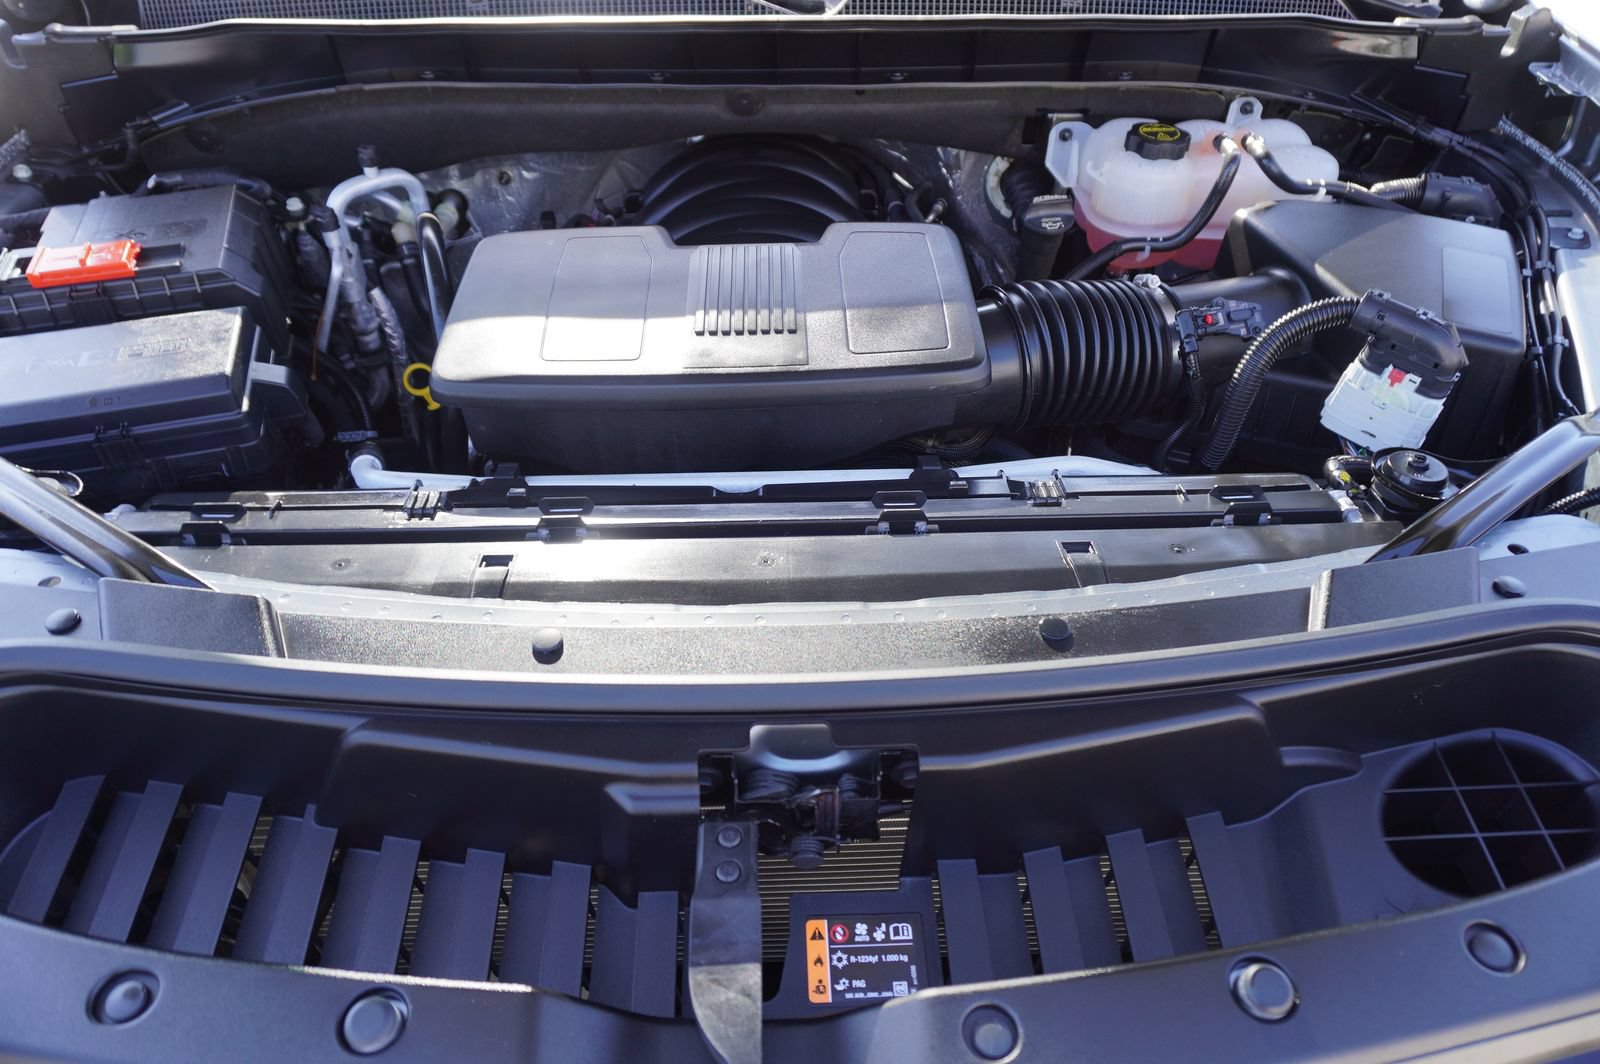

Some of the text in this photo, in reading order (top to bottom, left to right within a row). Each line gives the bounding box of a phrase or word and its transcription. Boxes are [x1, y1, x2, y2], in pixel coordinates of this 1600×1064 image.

[850, 954, 908, 963] R-1234yf 1.000 kg
